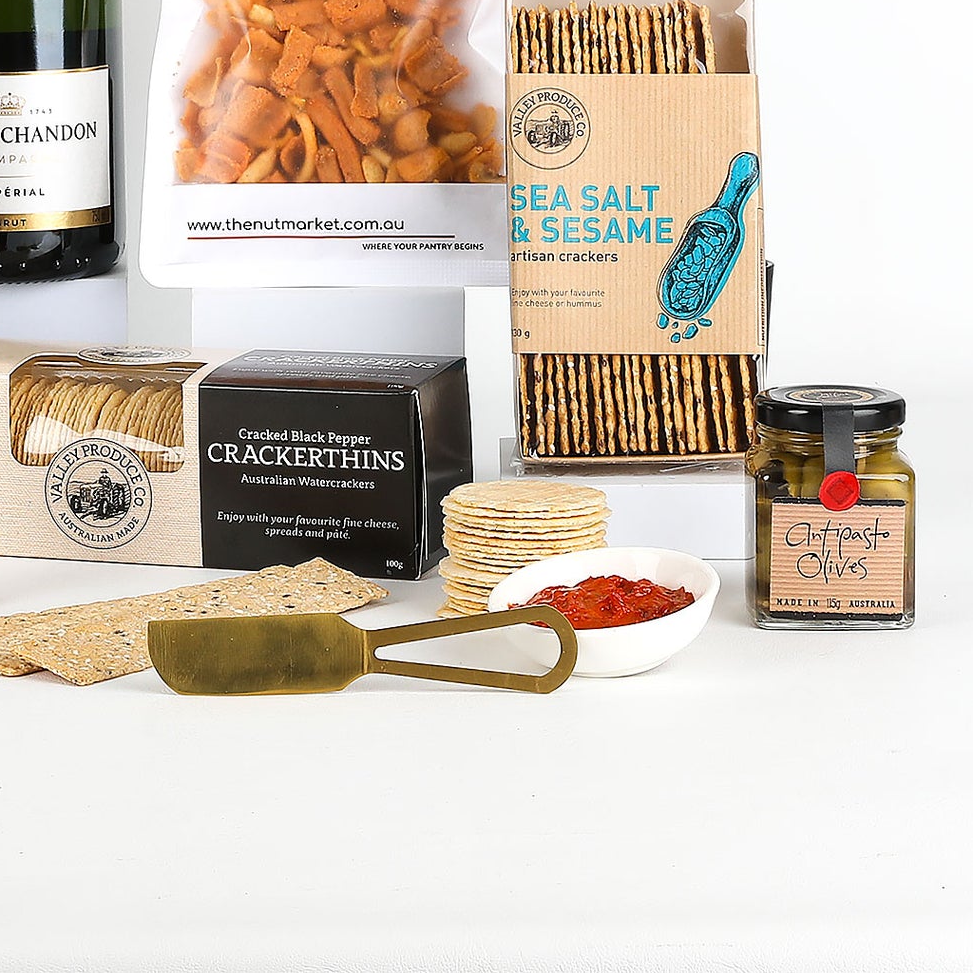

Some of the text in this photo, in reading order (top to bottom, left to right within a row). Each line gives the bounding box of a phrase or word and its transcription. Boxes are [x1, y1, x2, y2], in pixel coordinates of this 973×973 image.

[512, 96, 536, 138] VALLEY
[537, 91, 584, 123] PRODUCE
[0, 121, 98, 144] CHANDON
[511, 184, 660, 212] SEA SALT
[187, 217, 405, 231] www.thenutmarket.com.au
[511, 217, 674, 244] & SESAME
[362, 243, 485, 251] WHERE YOUR PANTRY BEGINS
[510, 250, 619, 263] artisan crackers
[511, 288, 606, 298] Enjoy with your favourite
[524, 299, 554, 307] cheese
[566, 299, 602, 307] hummus
[238, 427, 372, 447] Cracked Black Pepper
[207, 442, 405, 471] CRACKERTHINS
[51, 450, 80, 503] VALLEY
[82, 443, 144, 484] PRODUCE
[240, 473, 376, 490] Australian Watercrackers
[58, 511, 140, 543] AUSTRALIAN MADE
[217, 511, 400, 531] Enjoy with your favourite fine cheese,
[264, 526, 303, 538] spreads
[304, 528, 324, 538] and
[785, 517, 891, 559] Antipasto
[385, 559, 403, 570] 100g
[796, 550, 868, 584] Olives
[776, 598, 803, 607] MADE
[808, 599, 819, 607] IN
[849, 600, 896, 608] AUSTRALIA
